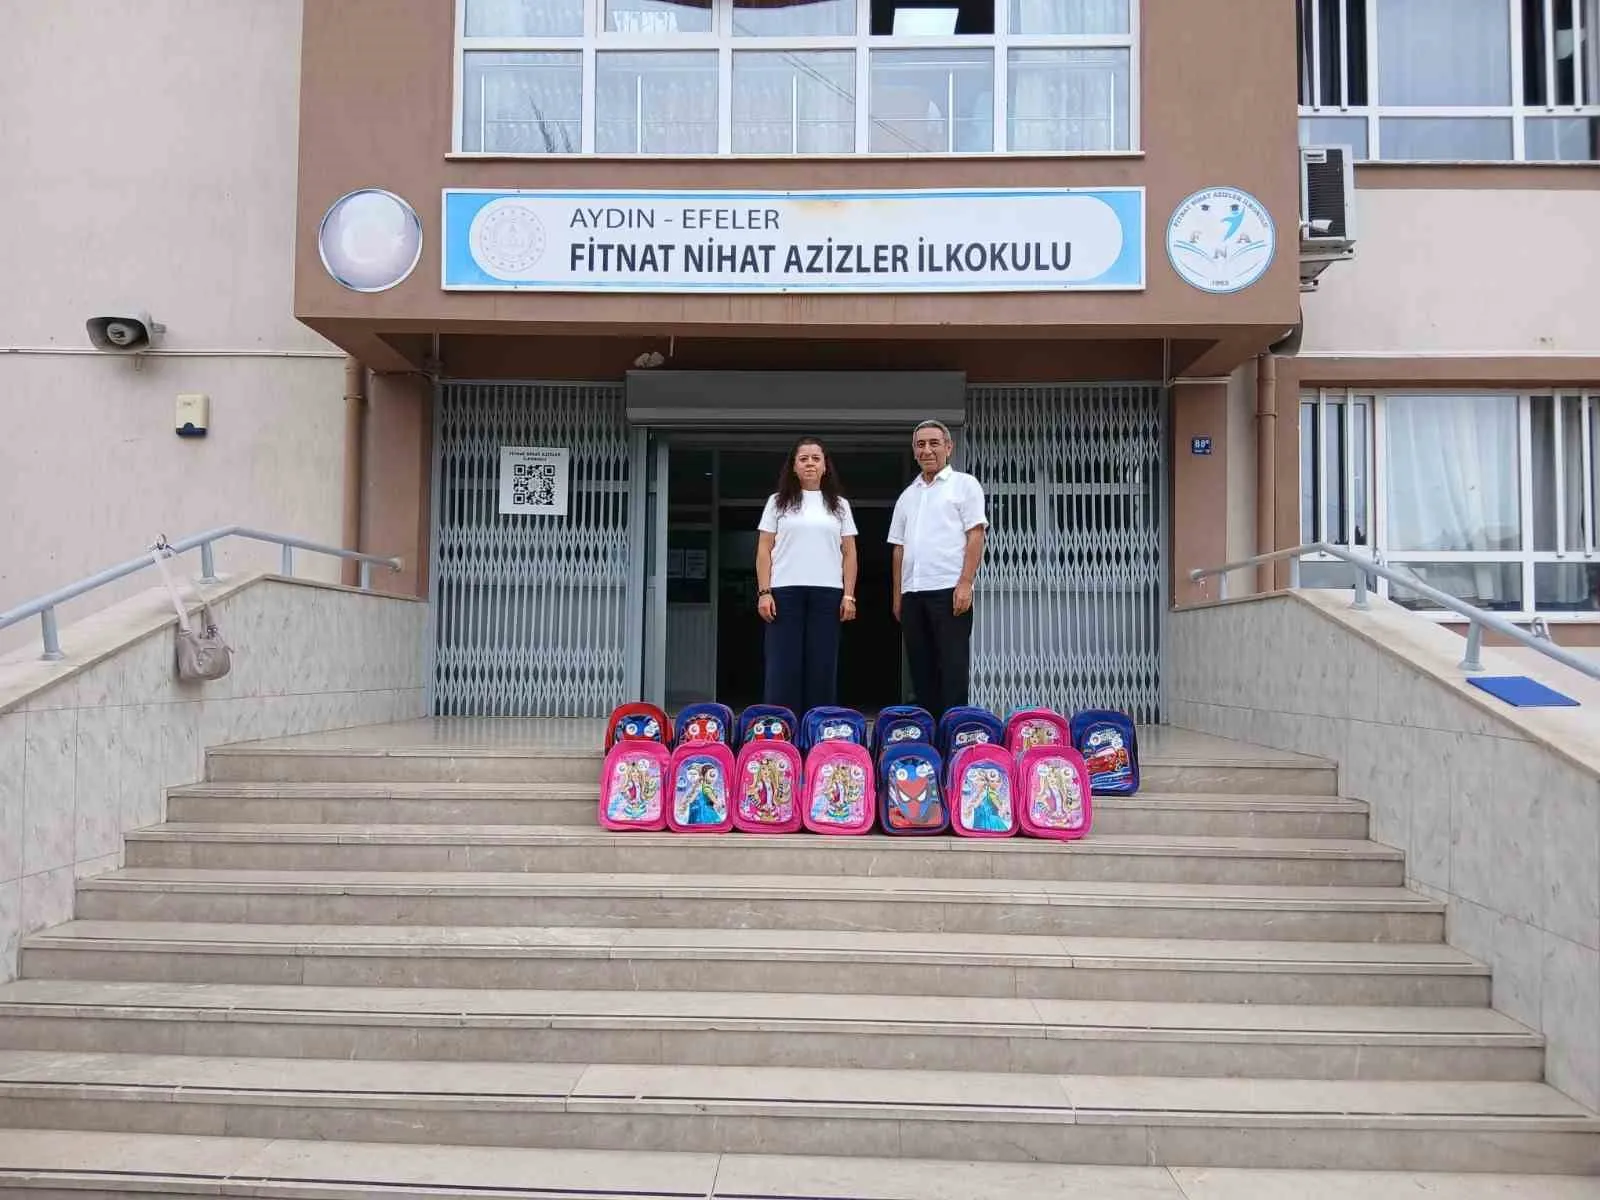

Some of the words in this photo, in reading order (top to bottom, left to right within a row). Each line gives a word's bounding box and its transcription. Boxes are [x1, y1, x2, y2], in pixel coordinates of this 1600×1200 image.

[569, 207, 655, 229] AYDIN
[682, 208, 780, 230] EFELER
[570, 236, 676, 273] FİTNAT
[684, 237, 776, 273] NİHAT
[783, 236, 909, 274] AZİZLER
[918, 236, 1072, 273] İLKOKULU
